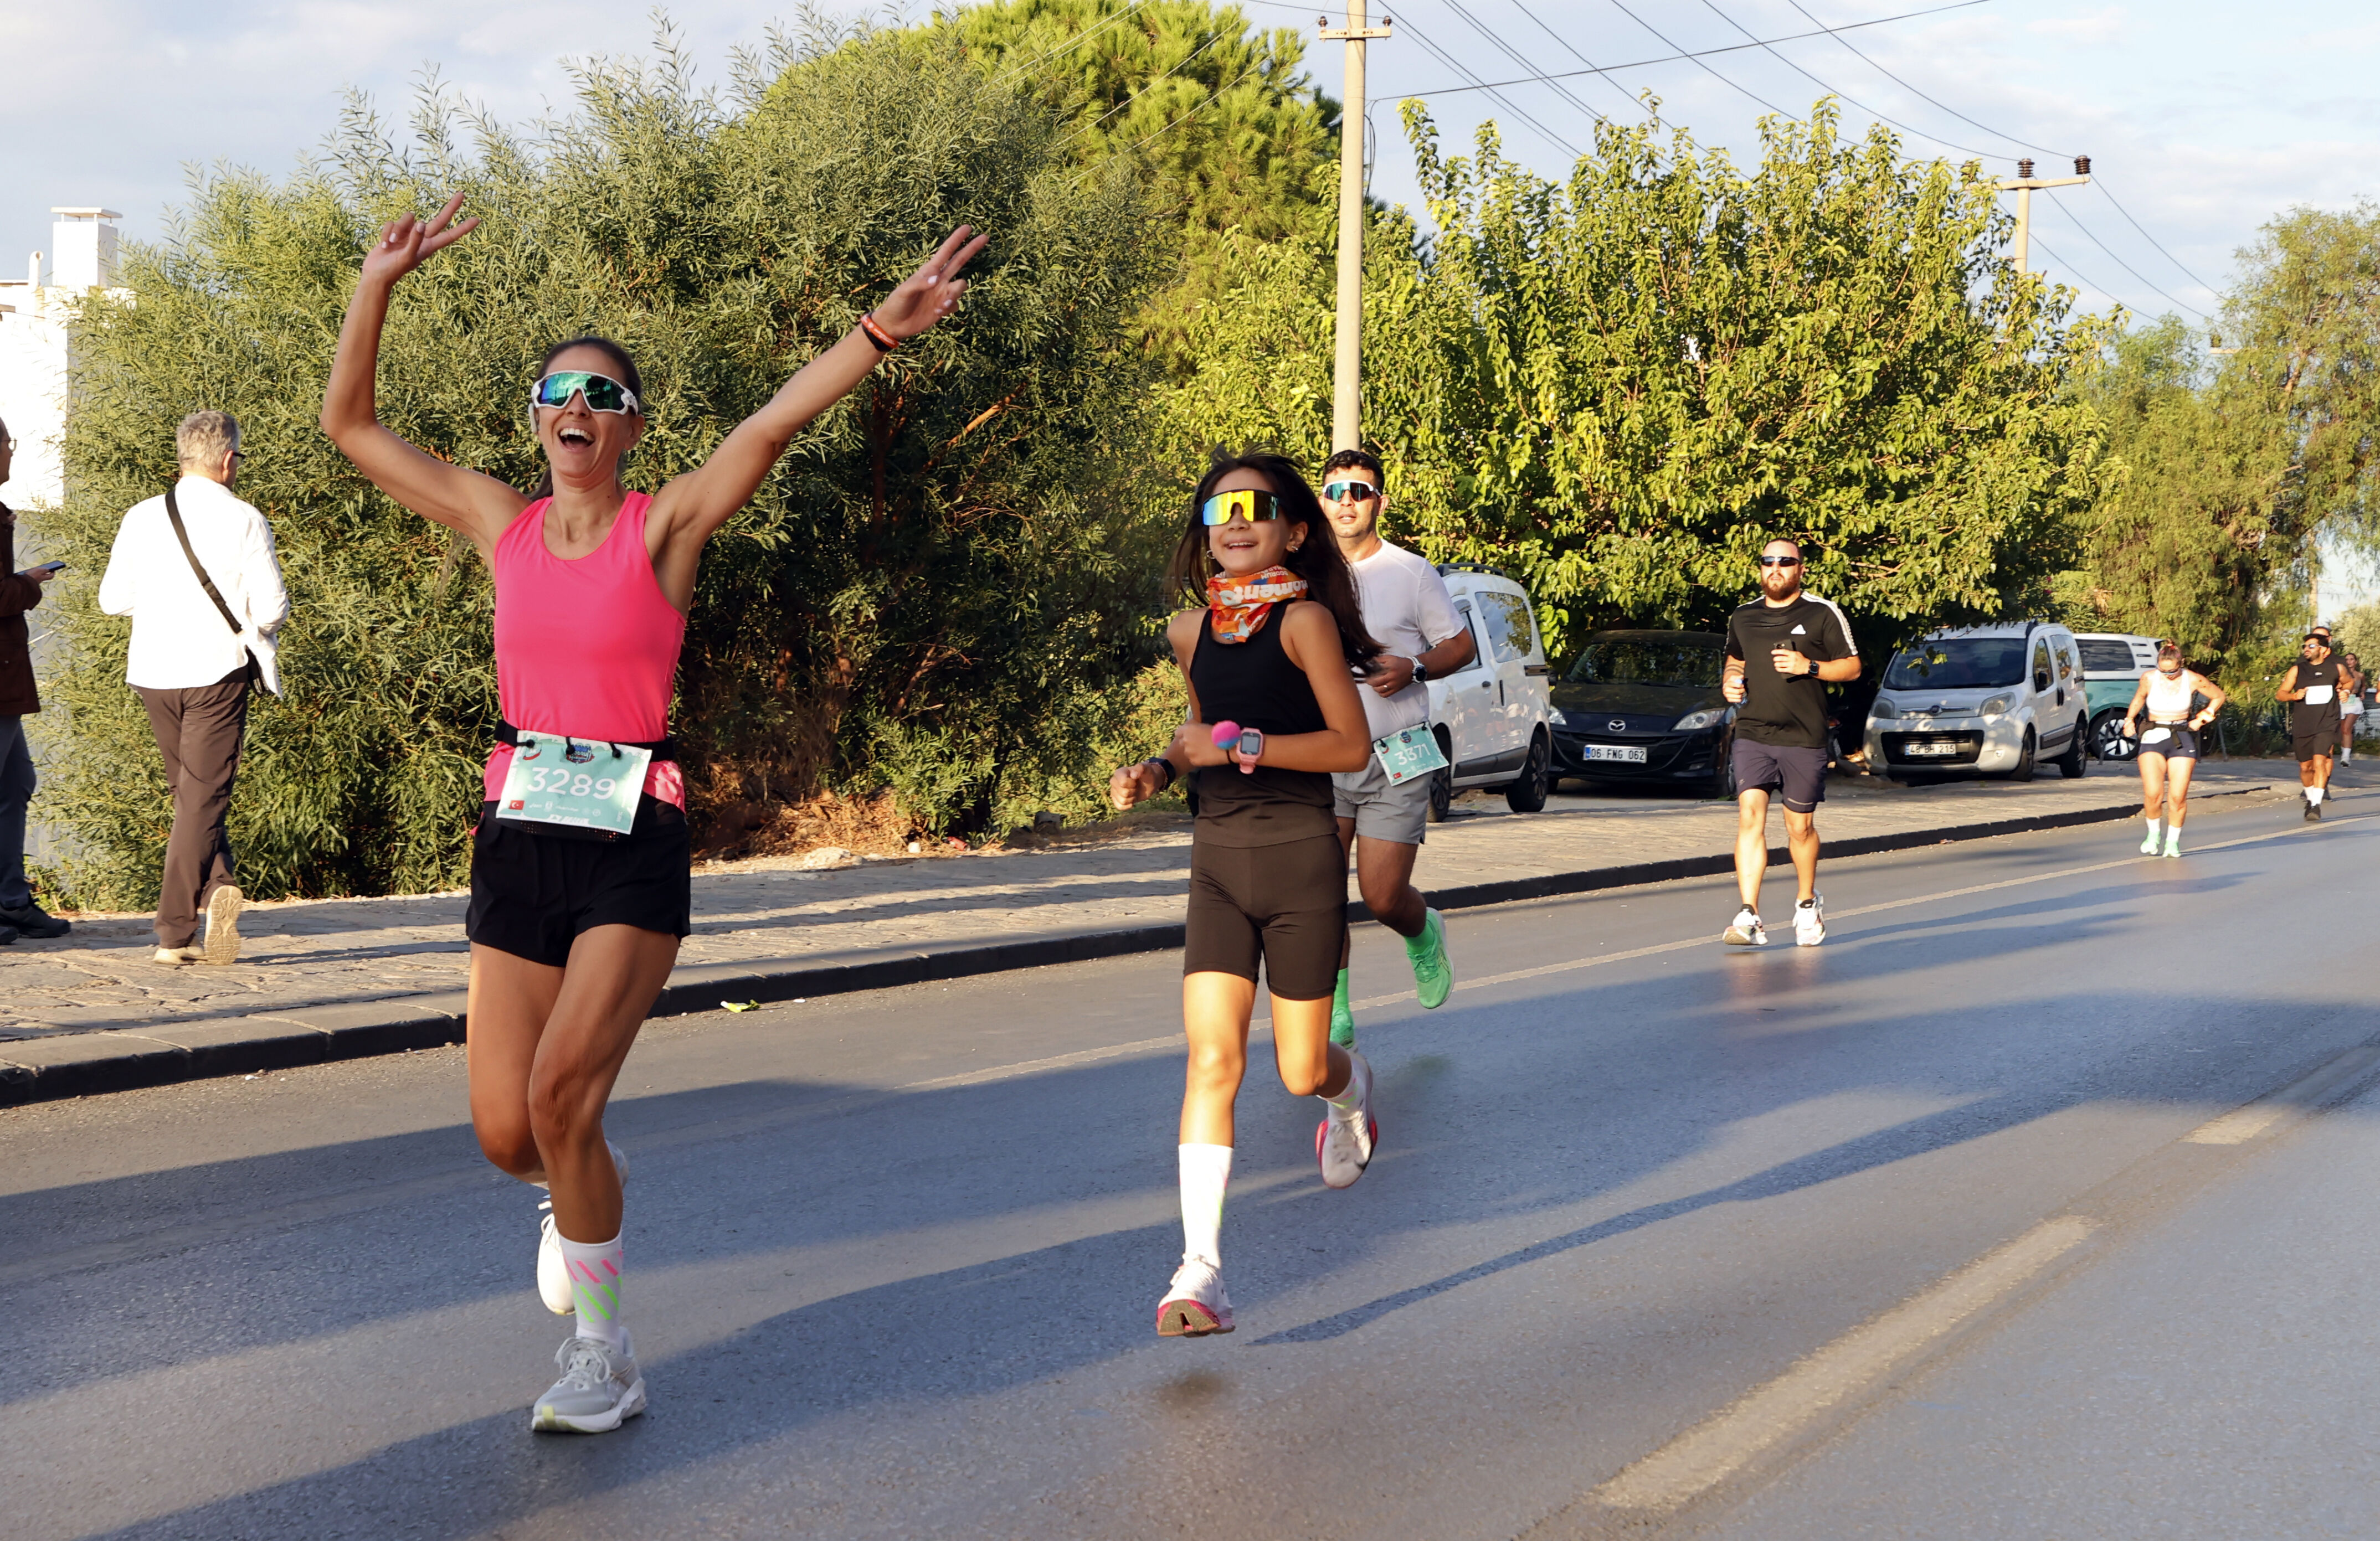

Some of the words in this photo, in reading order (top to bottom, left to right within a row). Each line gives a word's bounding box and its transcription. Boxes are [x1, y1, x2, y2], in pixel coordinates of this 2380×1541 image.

[1394, 743, 1431, 765] 3371
[1591, 749, 1601, 758] 06
[1607, 749, 1623, 759] FWG
[1628, 750, 1644, 760] 062
[1939, 745, 1954, 753] 215
[527, 767, 616, 800] 3289
